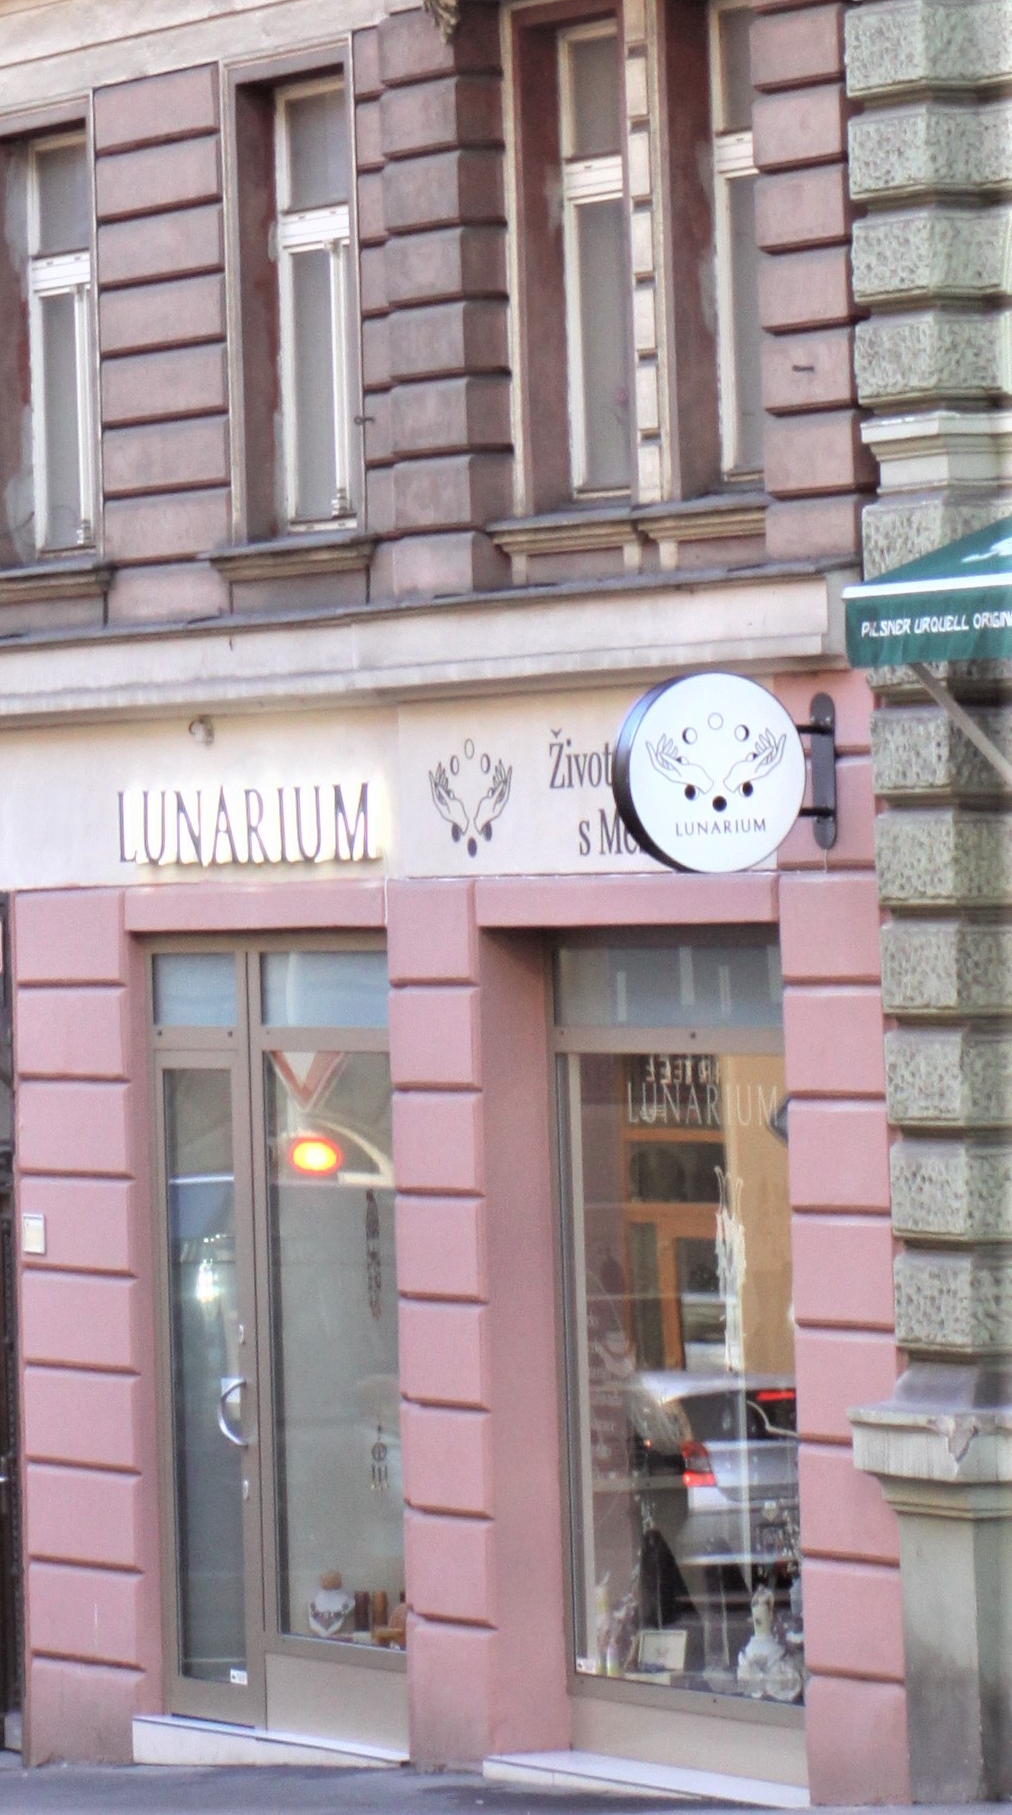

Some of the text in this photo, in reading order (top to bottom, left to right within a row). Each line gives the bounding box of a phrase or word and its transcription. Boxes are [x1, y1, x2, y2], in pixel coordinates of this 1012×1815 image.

[861, 618, 911, 638] PILSNER
[914, 614, 970, 635] URQUELL
[117, 782, 372, 867] LUNARIUM
[578, 820, 591, 856] s
[675, 818, 767, 837] LUNARIUM
[627, 1081, 779, 1127] LUNARIUM
